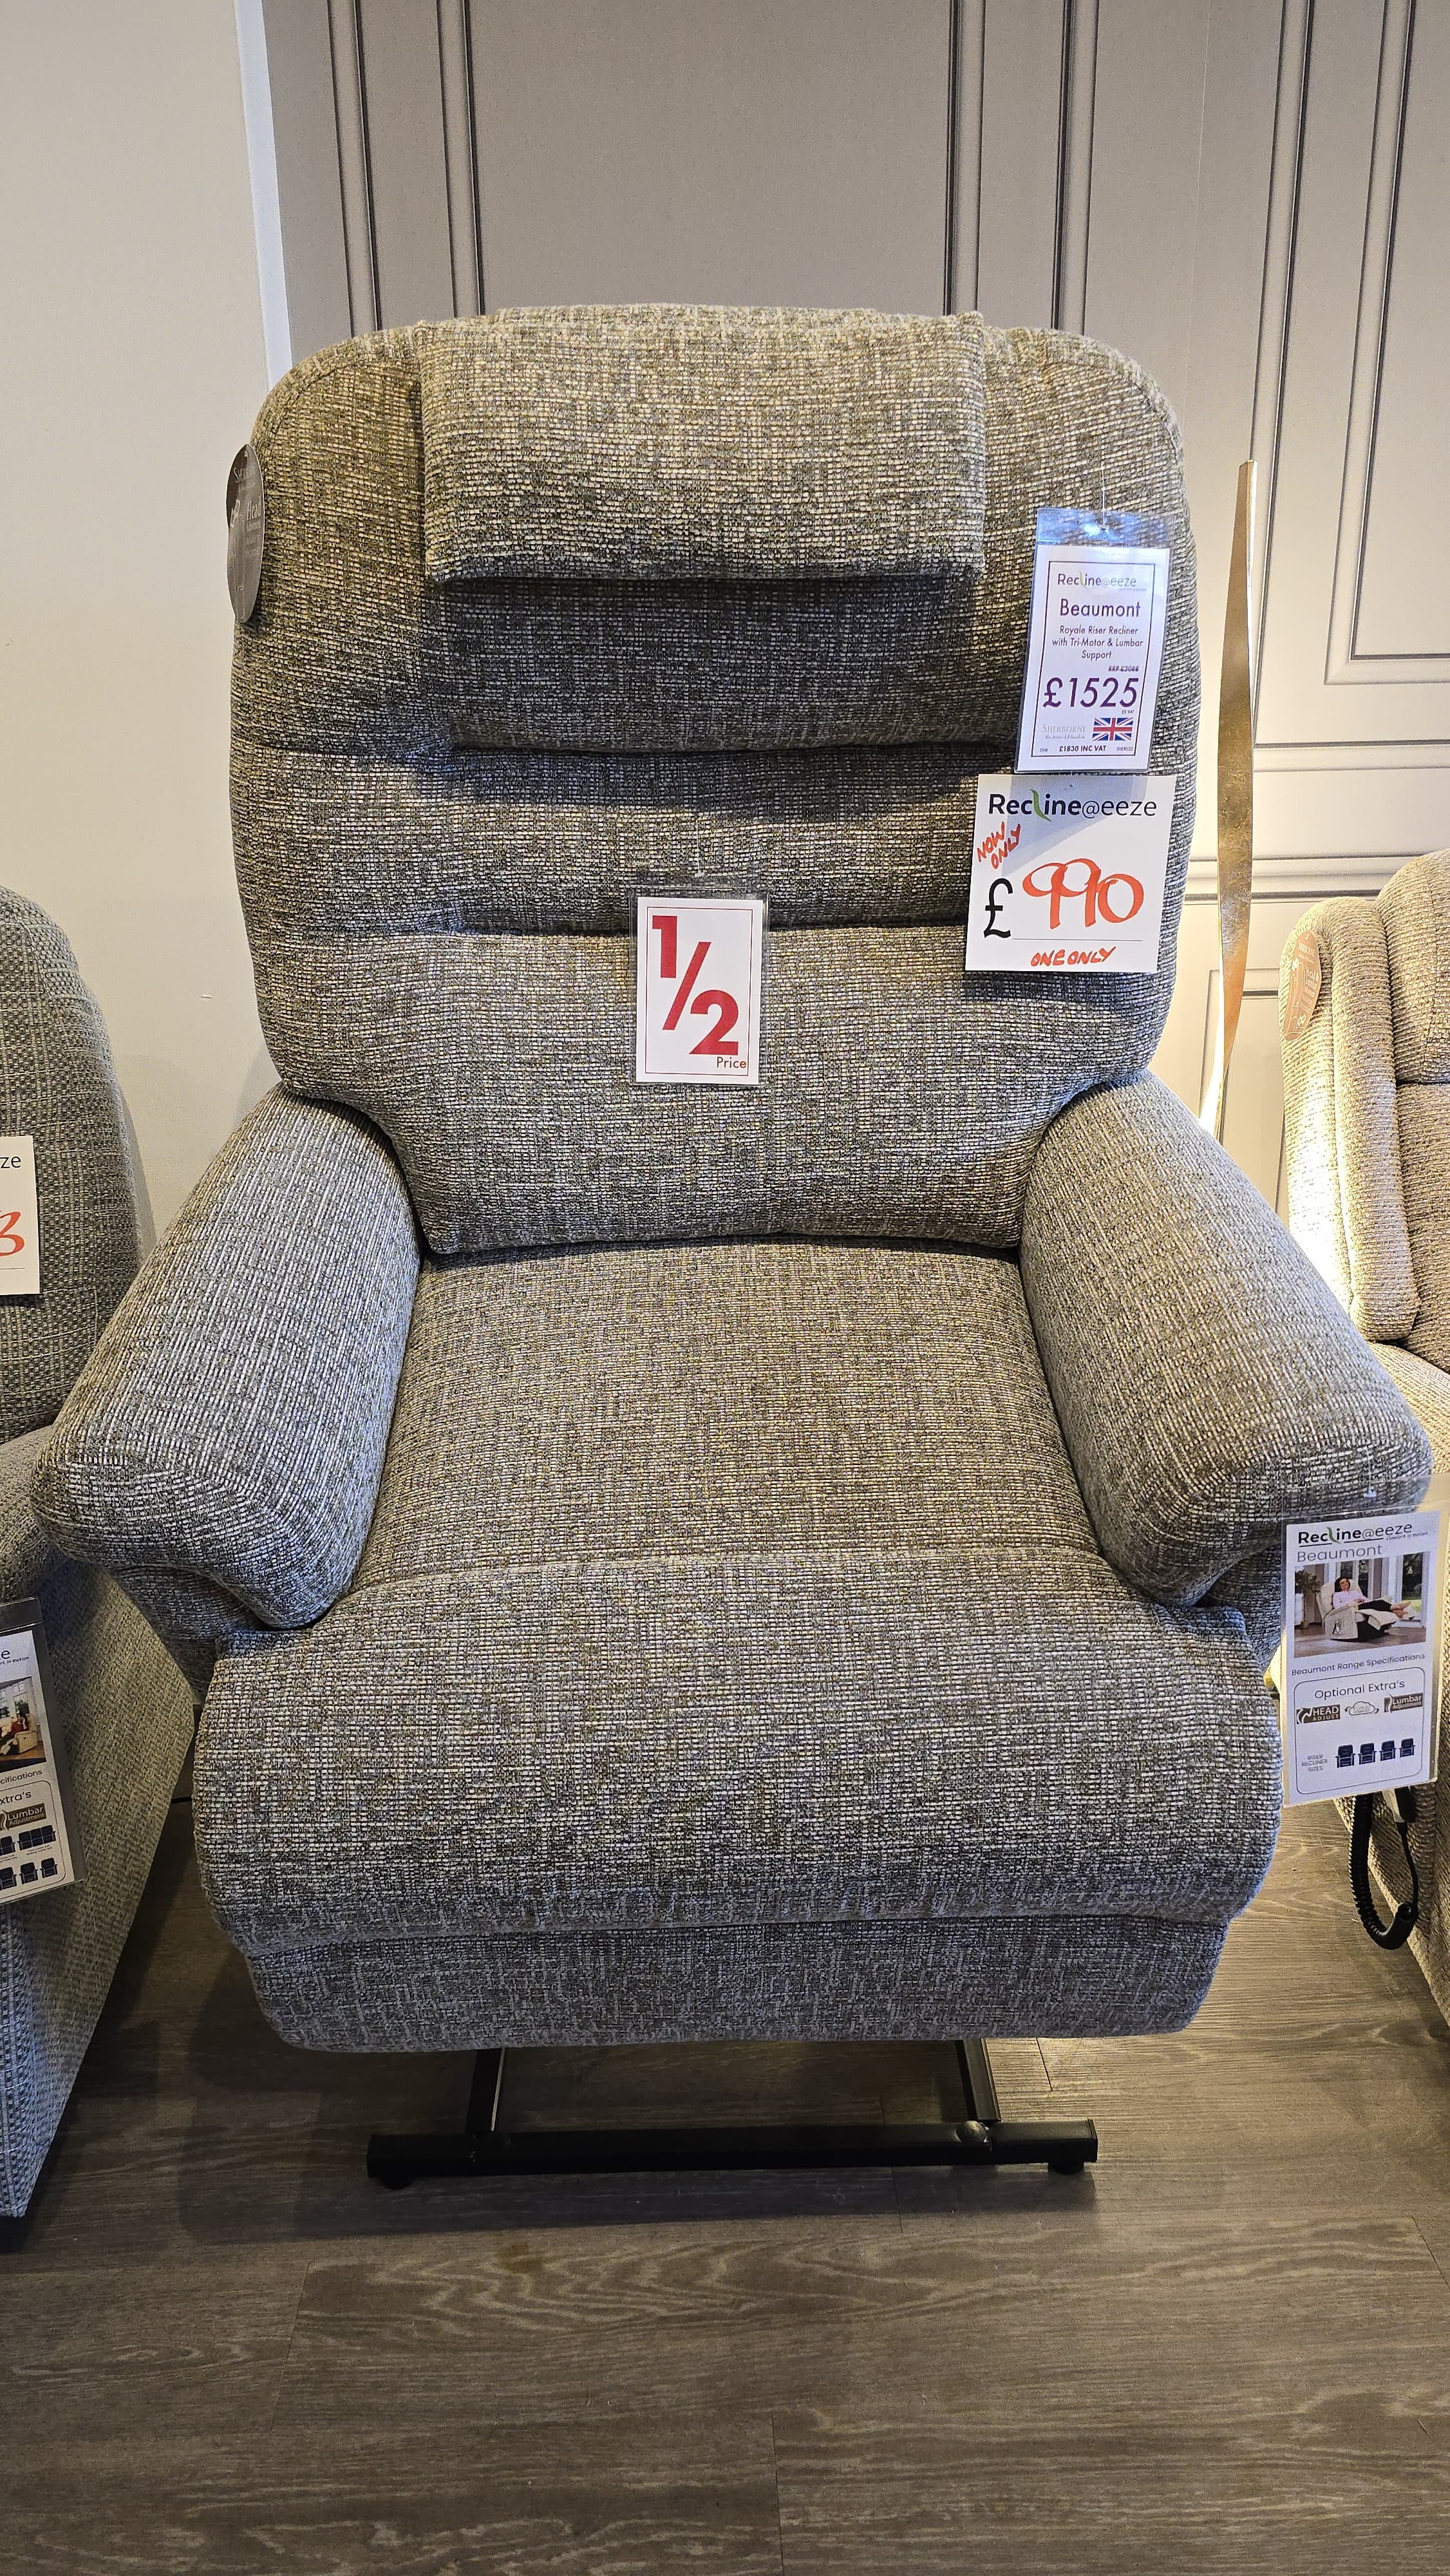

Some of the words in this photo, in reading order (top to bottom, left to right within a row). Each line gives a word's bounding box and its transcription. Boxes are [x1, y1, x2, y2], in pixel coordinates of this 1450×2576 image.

[1060, 598, 1141, 618] Beaumont
[1059, 625, 1086, 637] Royale
[1088, 625, 1106, 634] Riser
[1109, 625, 1138, 635] Recliner
[1052, 638, 1068, 646] with
[1070, 638, 1105, 647] Tri-Motor
[1107, 638, 1113, 647] &
[1116, 638, 1144, 647] Lumbar
[1081, 649, 1112, 661] Support
[1042, 677, 1139, 709] £1525
[977, 821, 1005, 862] NOW
[991, 824, 1021, 869] ONLY
[1031, 950, 1065, 967] ONE
[1067, 947, 1116, 965] ONLY
[652, 915, 739, 1056] 1/2
[717, 1057, 747, 1069] Price
[1297, 1545, 1383, 1562] Beaumont
[1292, 1665, 1335, 1676] Beaumont
[1337, 1662, 1364, 1670] Range
[1366, 1654, 1426, 1667] Specifications
[1315, 1684, 1365, 1700] Optional
[1368, 1680, 1405, 1692] Extra's
[1393, 1694, 1422, 1705] Lumbar
[1313, 1706, 1339, 1717] HEAD
[8, 1806, 43, 1821] Lumbar
[9, 1812, 45, 1826] Adjustment
